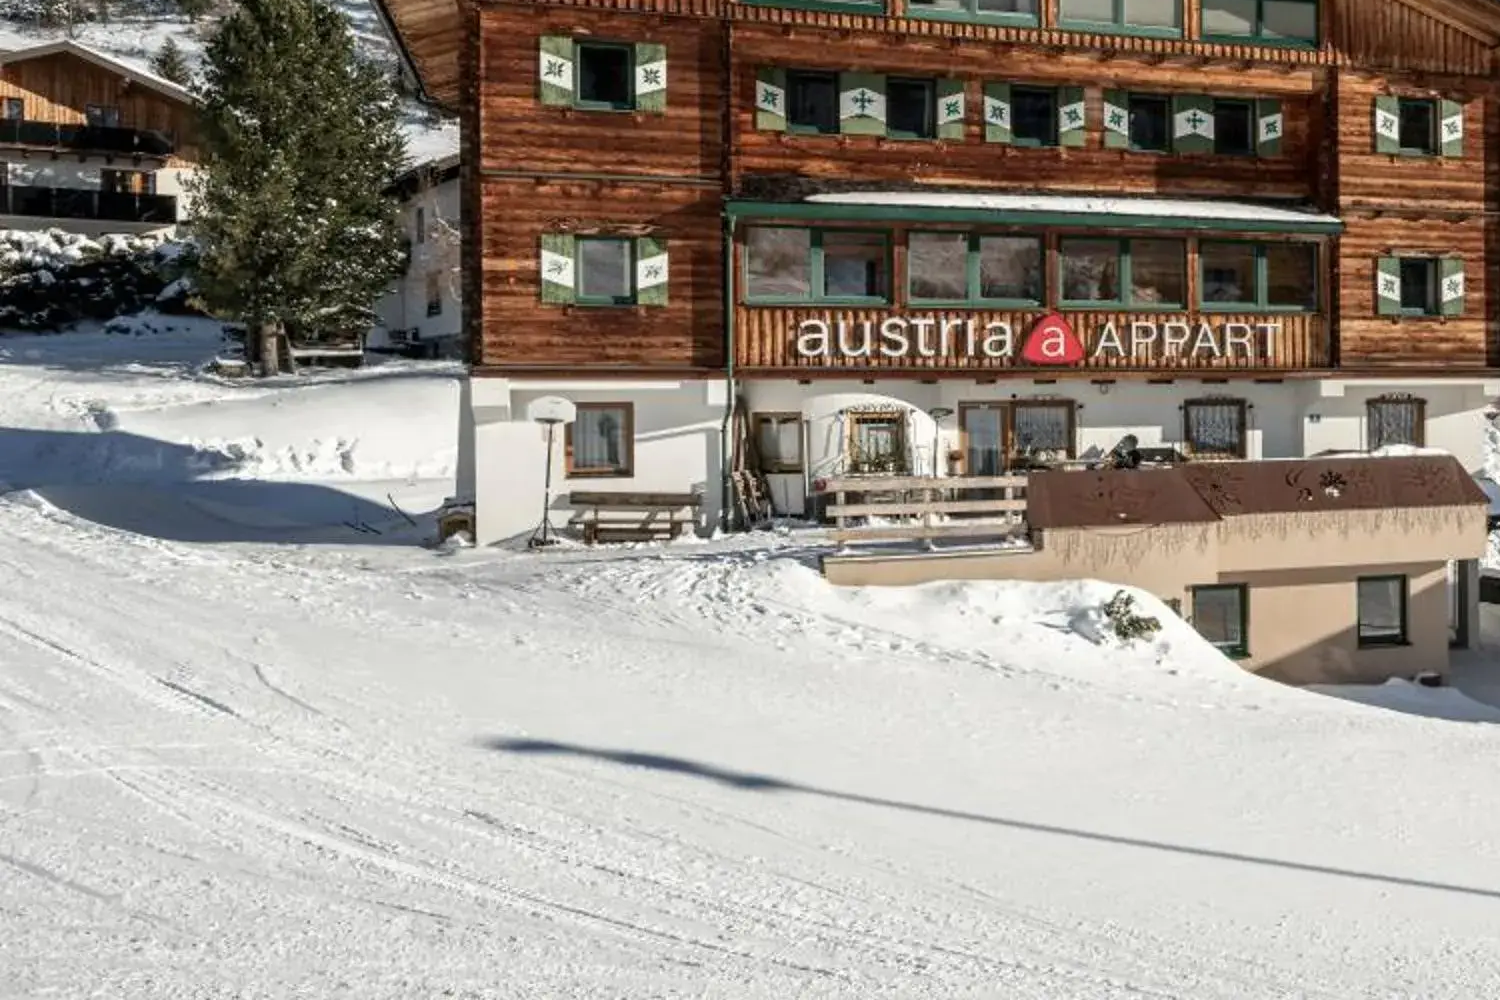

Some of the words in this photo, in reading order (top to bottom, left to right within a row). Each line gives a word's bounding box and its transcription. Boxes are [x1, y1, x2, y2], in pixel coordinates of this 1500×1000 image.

[797, 315, 1014, 357] austria
[1041, 326, 1066, 357] a
[1094, 321, 1282, 357] APPART
